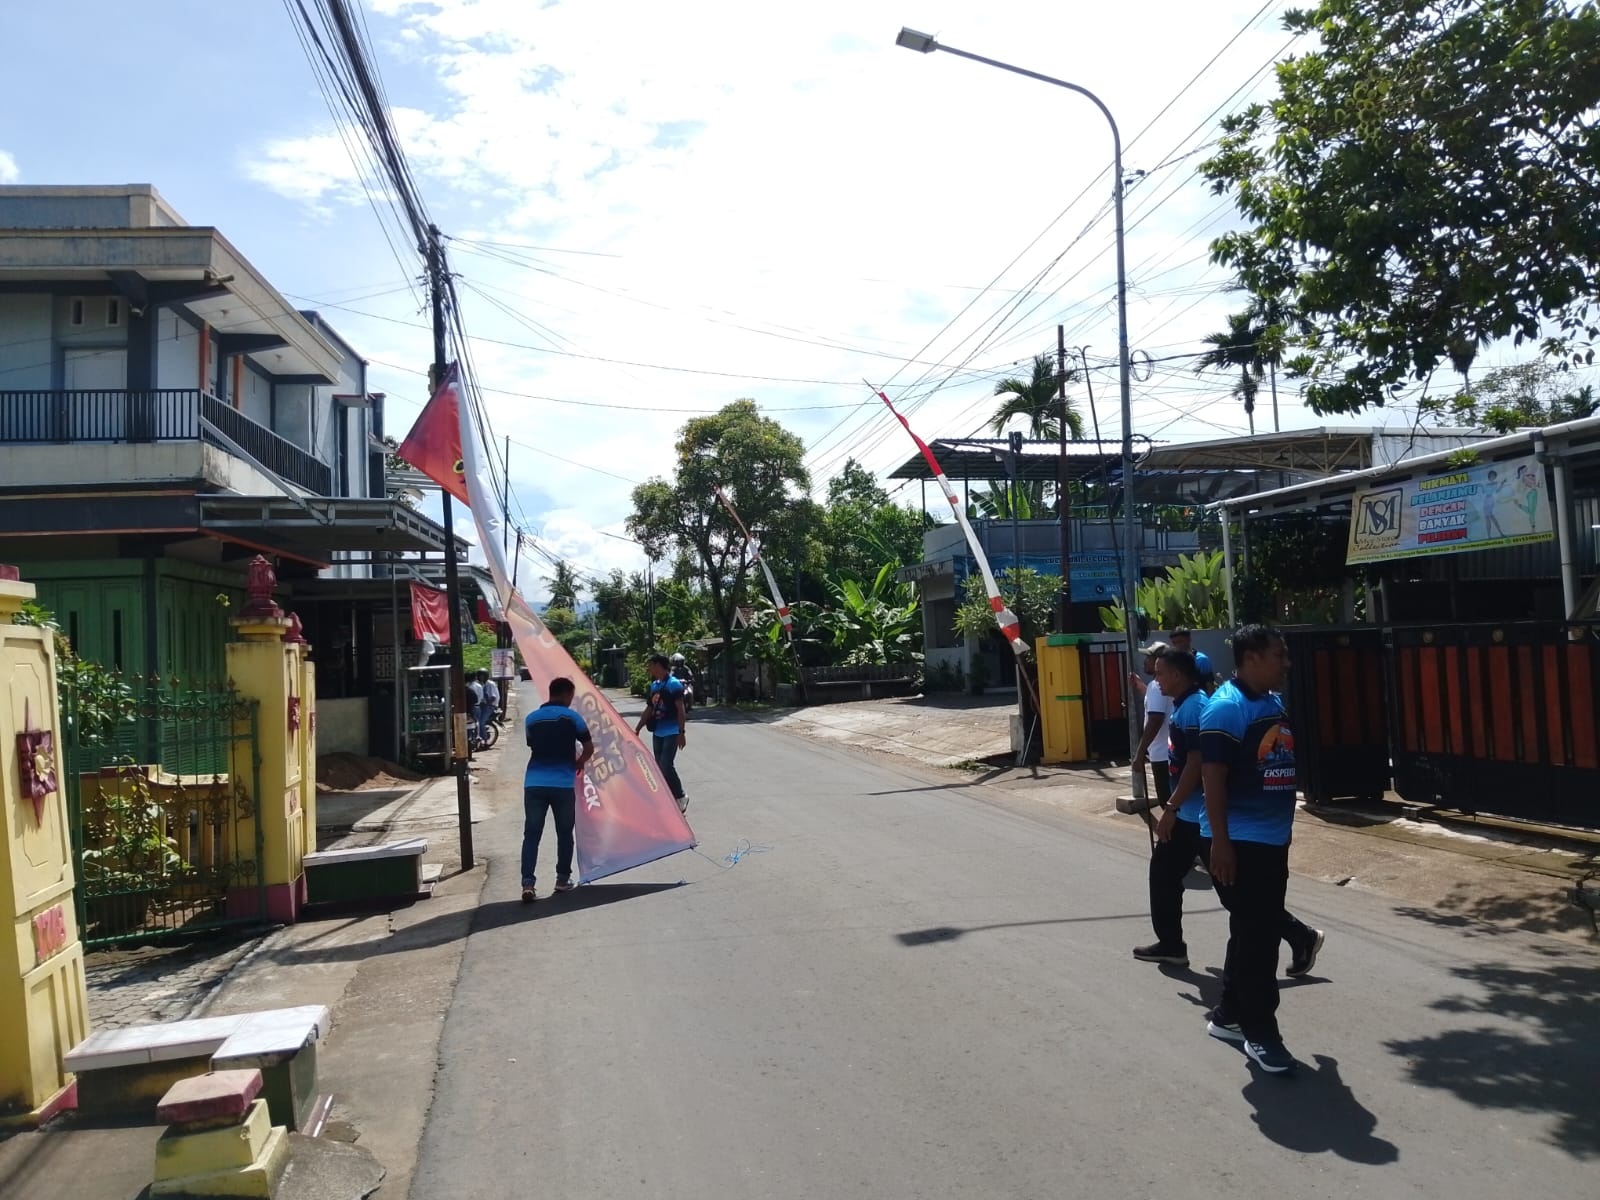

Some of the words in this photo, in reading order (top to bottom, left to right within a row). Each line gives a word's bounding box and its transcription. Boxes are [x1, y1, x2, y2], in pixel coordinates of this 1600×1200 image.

[1419, 472, 1469, 491] NIKMATI
[1411, 484, 1477, 507] BELANJAMU
[1419, 500, 1466, 518] DENGAN
[1418, 513, 1468, 531] BANYAK
